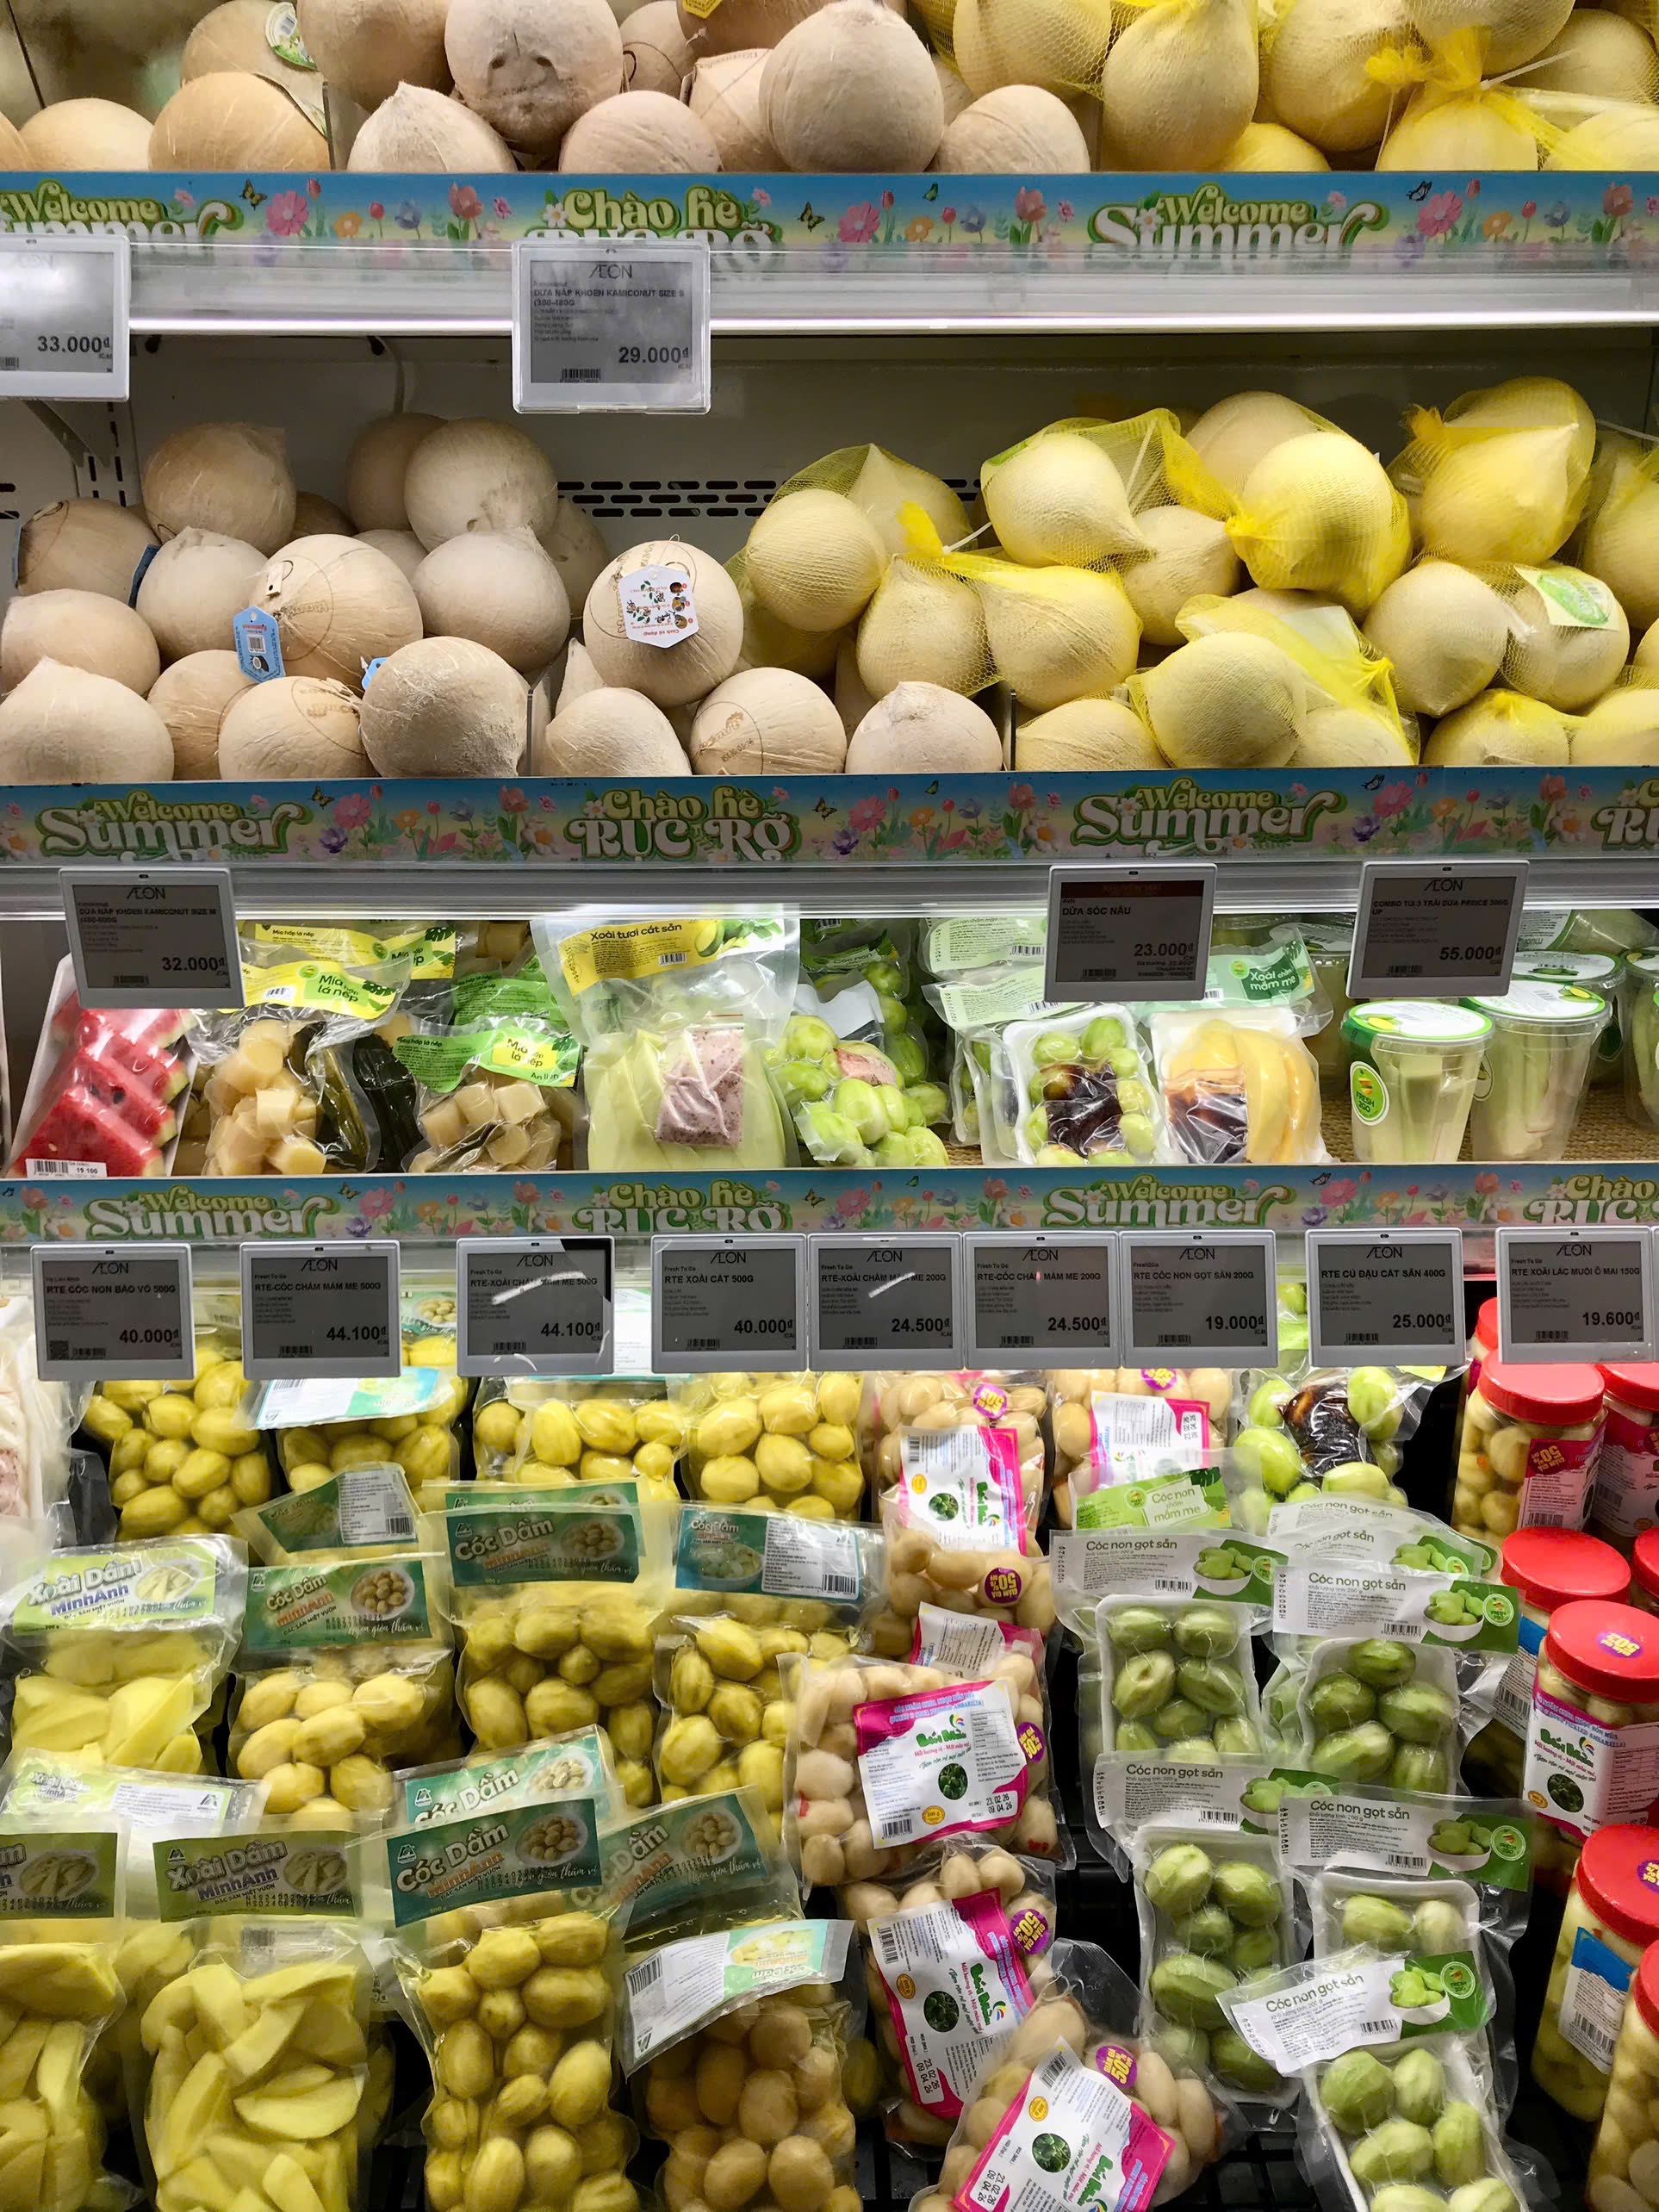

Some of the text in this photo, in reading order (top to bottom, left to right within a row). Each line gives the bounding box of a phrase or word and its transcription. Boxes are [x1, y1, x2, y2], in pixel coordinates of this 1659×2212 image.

[7, 181, 160, 224] Welcome
[562, 184, 740, 231] Chào hè
[1159, 181, 1308, 226] Welcome
[1094, 202, 1381, 262] Summer
[95, 792, 237, 823] Welcome
[603, 786, 763, 821] Chào hè
[1139, 779, 1273, 810] Welcome
[40, 802, 308, 860] Summer
[569, 817, 691, 861] RỰC
[1075, 792, 1342, 858] Summer
[591, 929, 615, 941] Xoài
[617, 929, 638, 939] tươi
[662, 923, 682, 933] sẵn
[319, 975, 345, 988] Mía
[1250, 971, 1276, 982] Xoài
[1282, 975, 1296, 987] me
[318, 985, 359, 1003] lá nếp
[1356, 1090, 1375, 1108] FRESH
[139, 1185, 272, 1212] Welcome
[606, 1180, 755, 1208] Chào hè
[1103, 1173, 1230, 1201] Welcome
[1565, 1175, 1656, 1200] Chào
[89, 1194, 334, 1240] Summer
[1045, 1184, 1292, 1228] Summer
[664, 1275, 683, 1283] RTE
[686, 1273, 708, 1283] XOÀI
[821, 1273, 861, 1283] RTE-XOÀI
[1424, 1269, 1445, 1277] 400G
[1152, 1488, 1195, 1504] Cóc non
[1183, 1505, 1201, 1517] me
[455, 1535, 499, 1561] Cóc
[1086, 1540, 1110, 1550] Cóc
[1111, 1540, 1133, 1550] non
[1134, 1539, 1155, 1553] gọt
[28, 1573, 82, 1606] Xoài
[1308, 1572, 1406, 1592] Cóc non gọt sẵn
[51, 1583, 129, 1617] MinhAnh
[266, 1590, 292, 1612] Cóc
[1126, 1764, 1152, 1775] Cóc
[1153, 1767, 1176, 1775] non
[1177, 1768, 1199, 1779] gọt
[1310, 1800, 1334, 1811] Cóc
[1337, 1804, 1361, 1814] non
[1363, 1805, 1386, 1820] gọt
[396, 1823, 510, 1892] Cóc Dầm
[167, 1856, 227, 1892] Xoài
[199, 1868, 279, 1902] MinhAnh
[1265, 1997, 1292, 2014] Cóc
[1293, 1988, 1319, 2005] non
[1318, 1981, 1339, 1997] gọt
